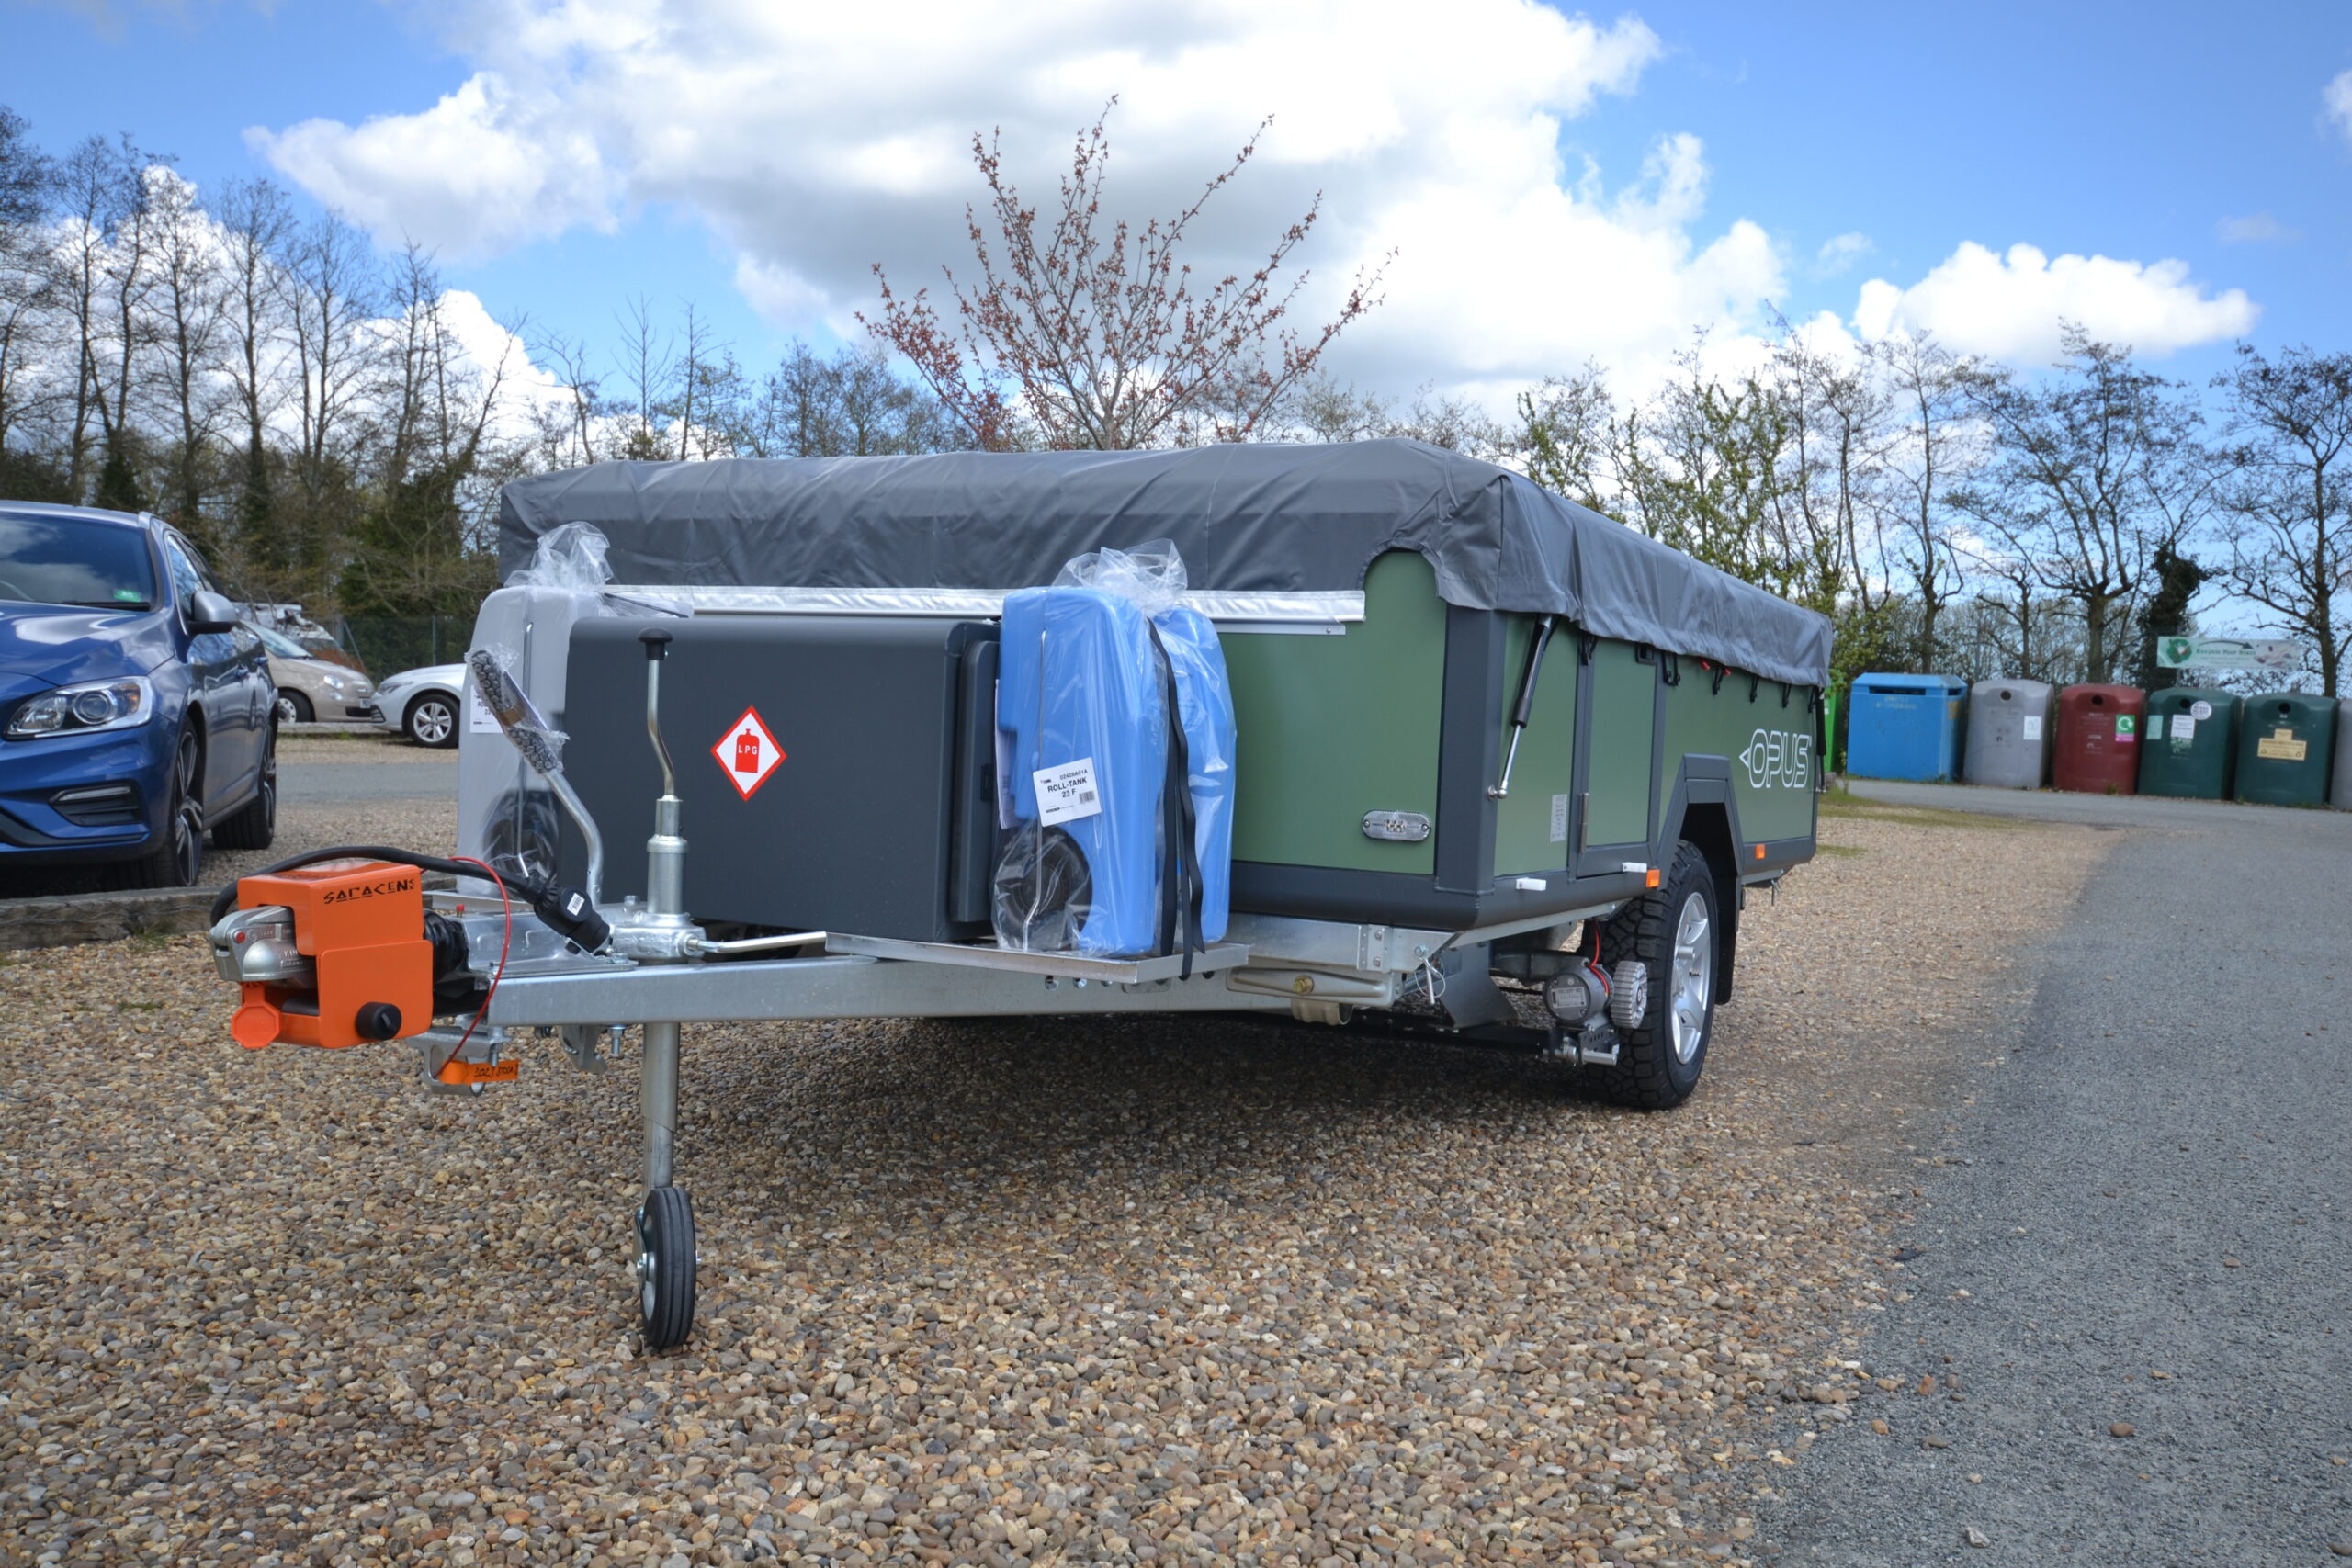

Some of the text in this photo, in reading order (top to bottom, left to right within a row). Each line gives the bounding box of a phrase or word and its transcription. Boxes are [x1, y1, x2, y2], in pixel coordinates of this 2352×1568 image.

[738, 744, 758, 755] LPG
[1748, 728, 1810, 789] OPUS
[1047, 776, 1088, 793] ROLL-TANK
[323, 879, 408, 905] SARACEN
